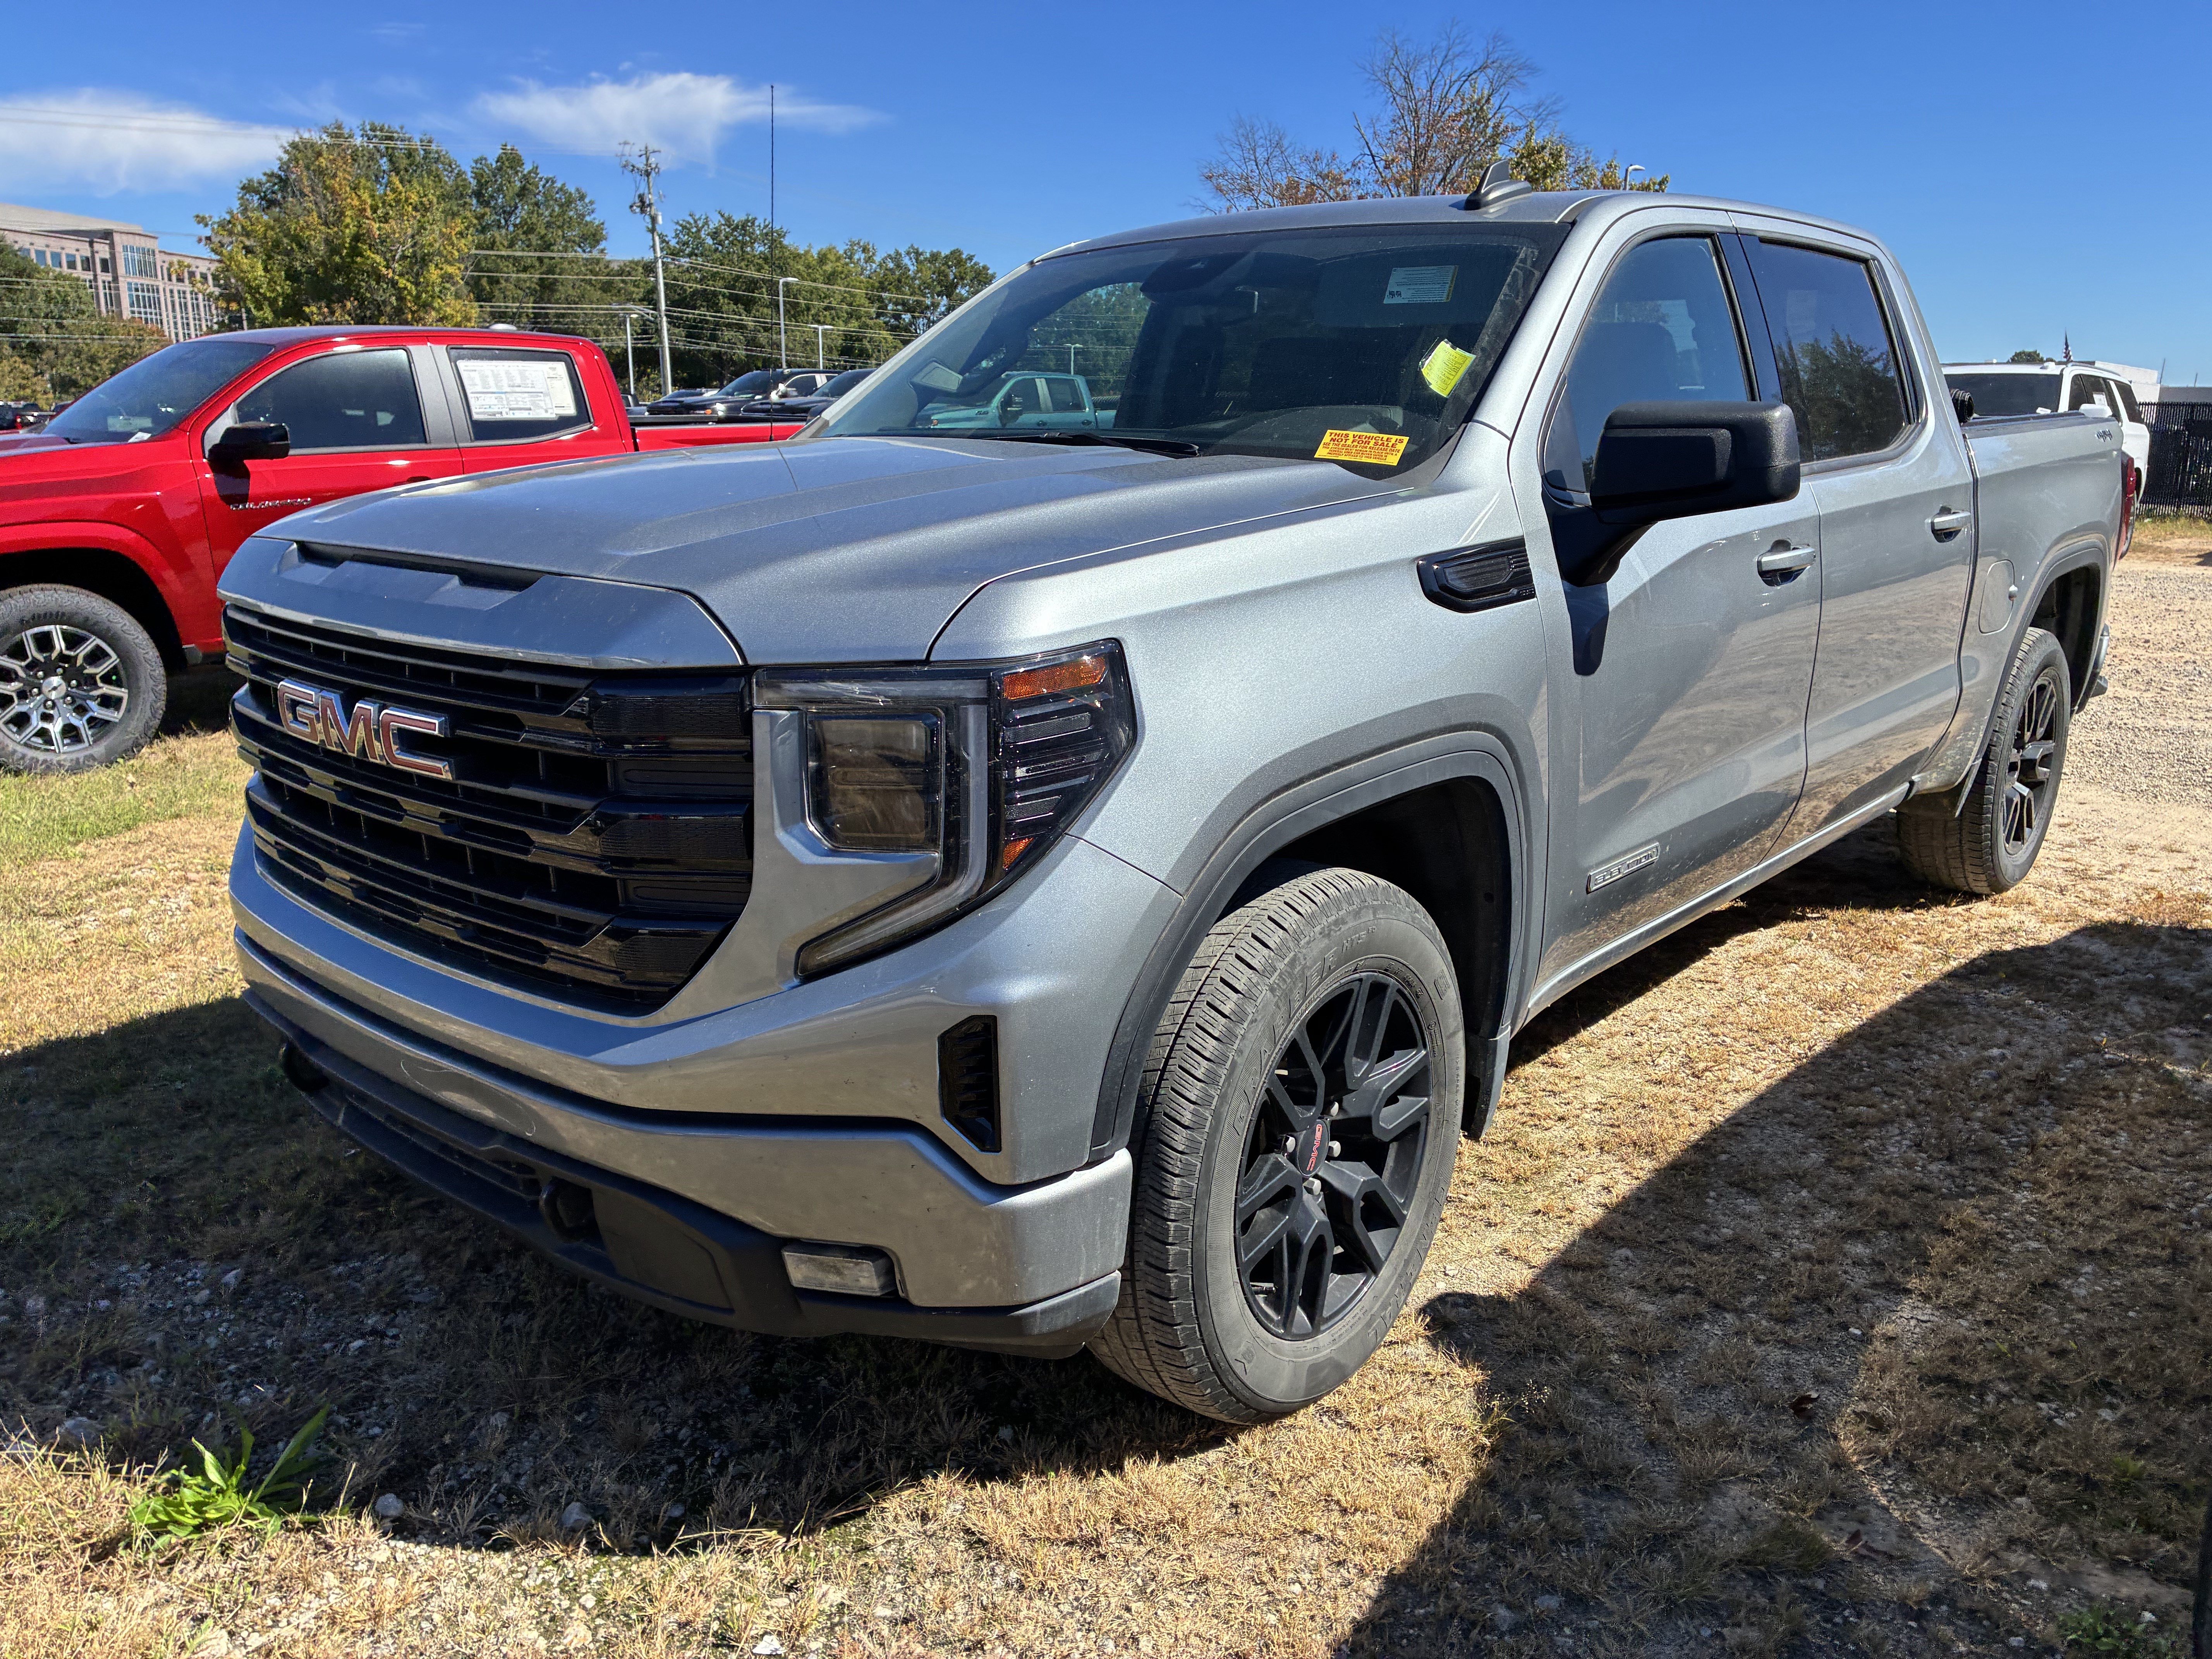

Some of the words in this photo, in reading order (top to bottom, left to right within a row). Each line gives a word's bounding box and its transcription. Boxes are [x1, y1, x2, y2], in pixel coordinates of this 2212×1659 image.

[1353, 434, 1393, 442] VEHICLE
[278, 679, 452, 780] GMC
[1307, 1124, 1322, 1171] GMC
